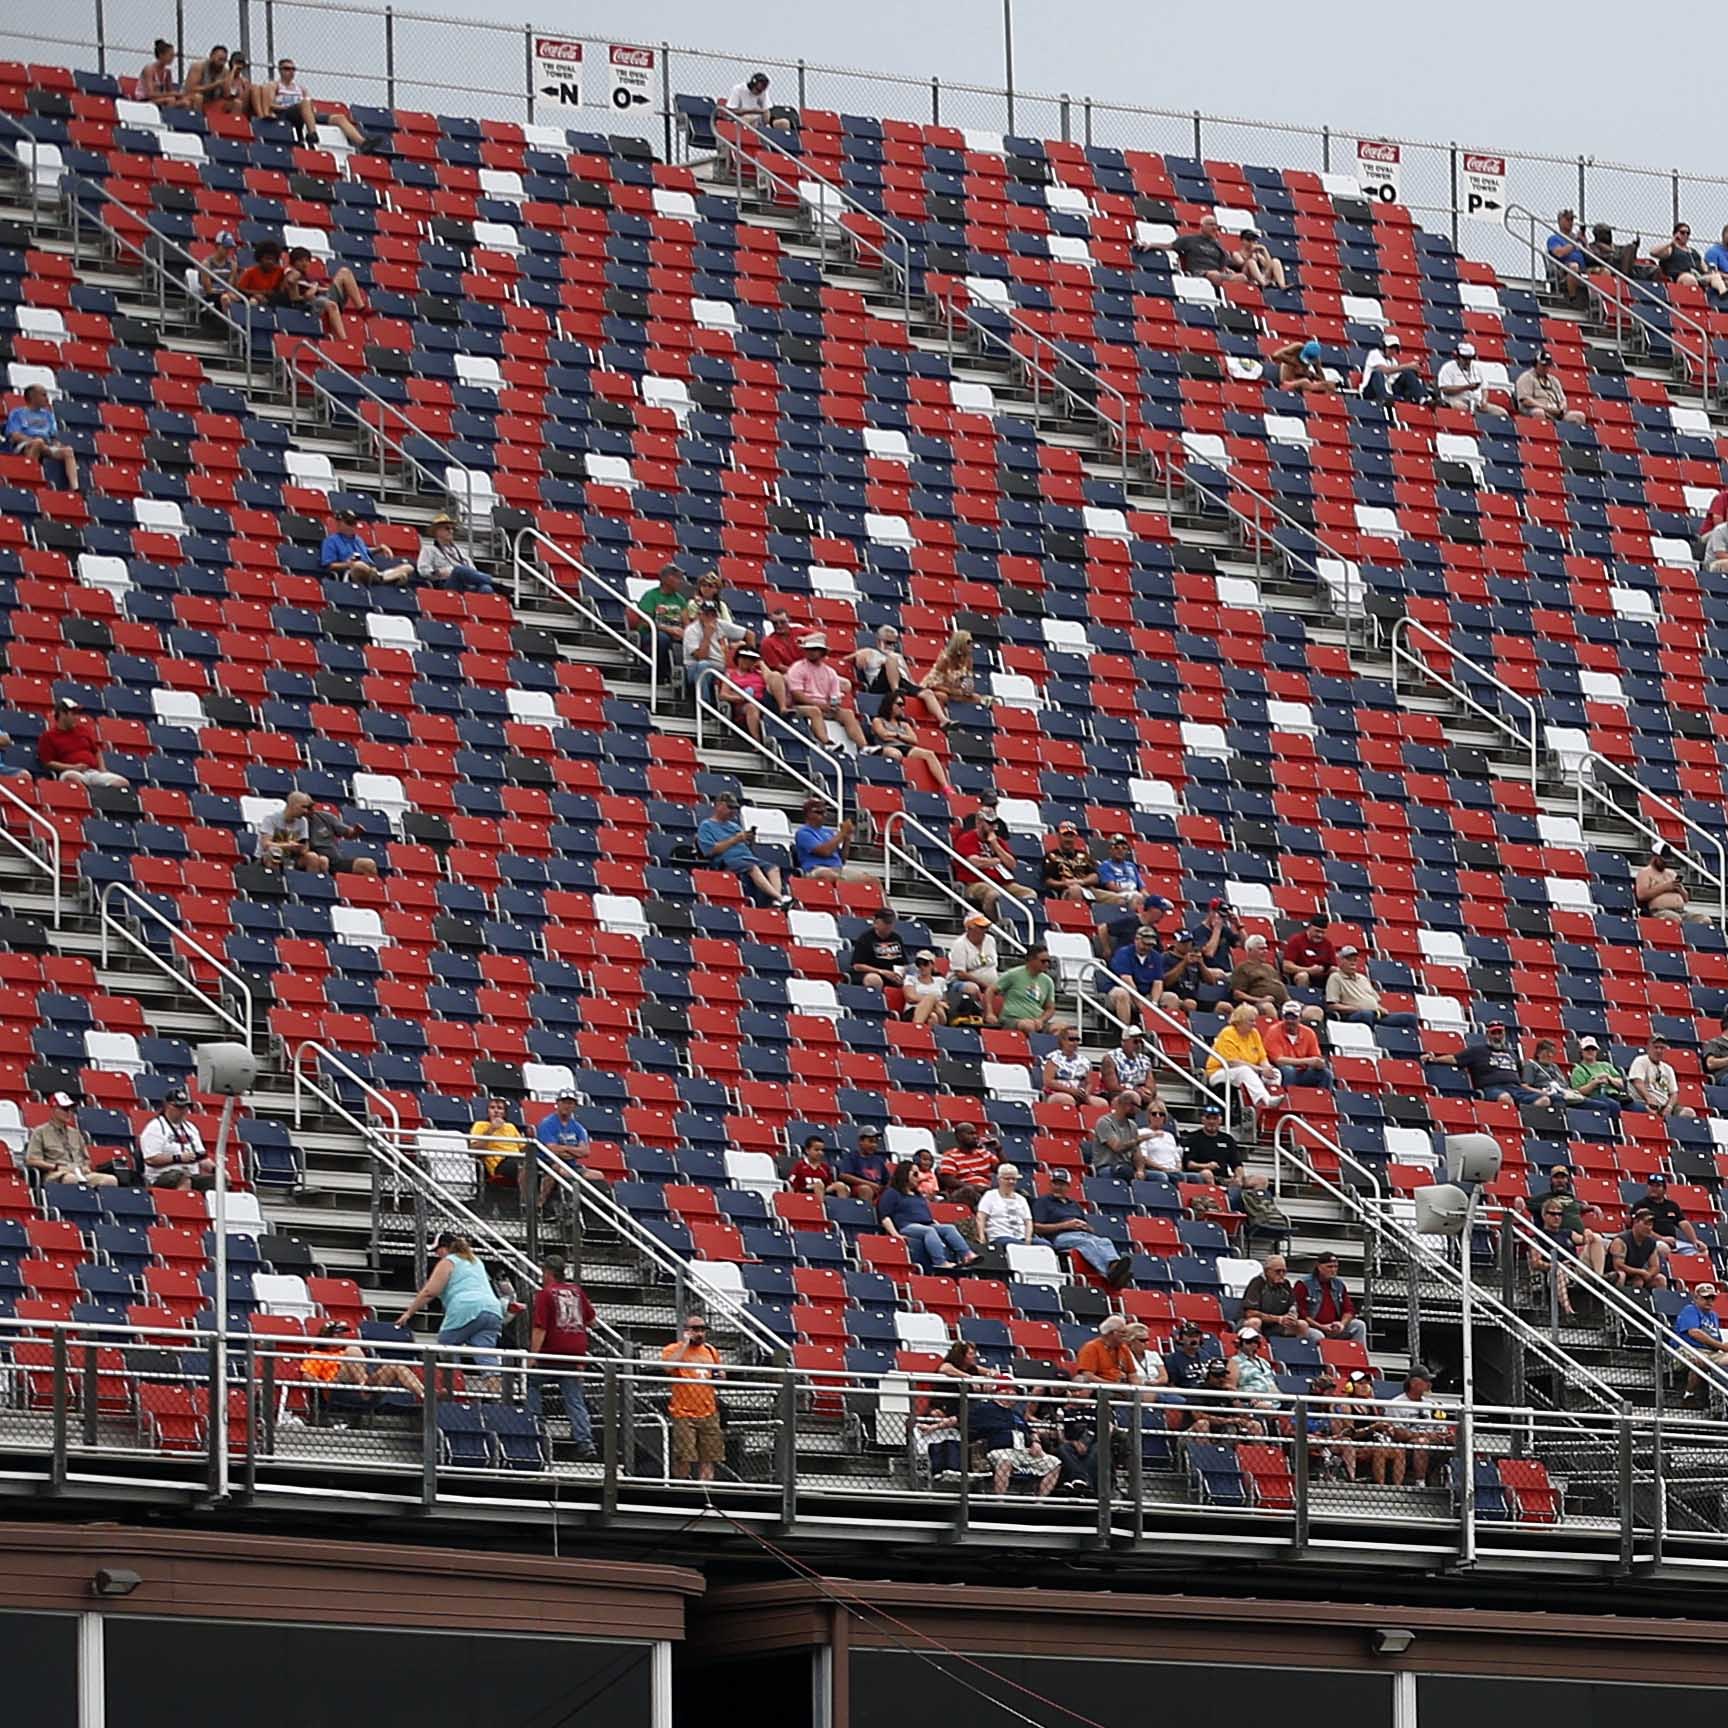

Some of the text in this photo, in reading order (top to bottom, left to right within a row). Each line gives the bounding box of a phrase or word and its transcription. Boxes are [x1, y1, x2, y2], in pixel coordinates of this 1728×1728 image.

[546, 70, 573, 80] TOWER
[619, 77, 646, 87] TOWER
[560, 83, 579, 106] N
[613, 87, 631, 109] O
[1366, 171, 1391, 180] TOWER
[1379, 184, 1396, 203] O
[1472, 184, 1497, 193] TOWER
[1468, 194, 1483, 214] P
